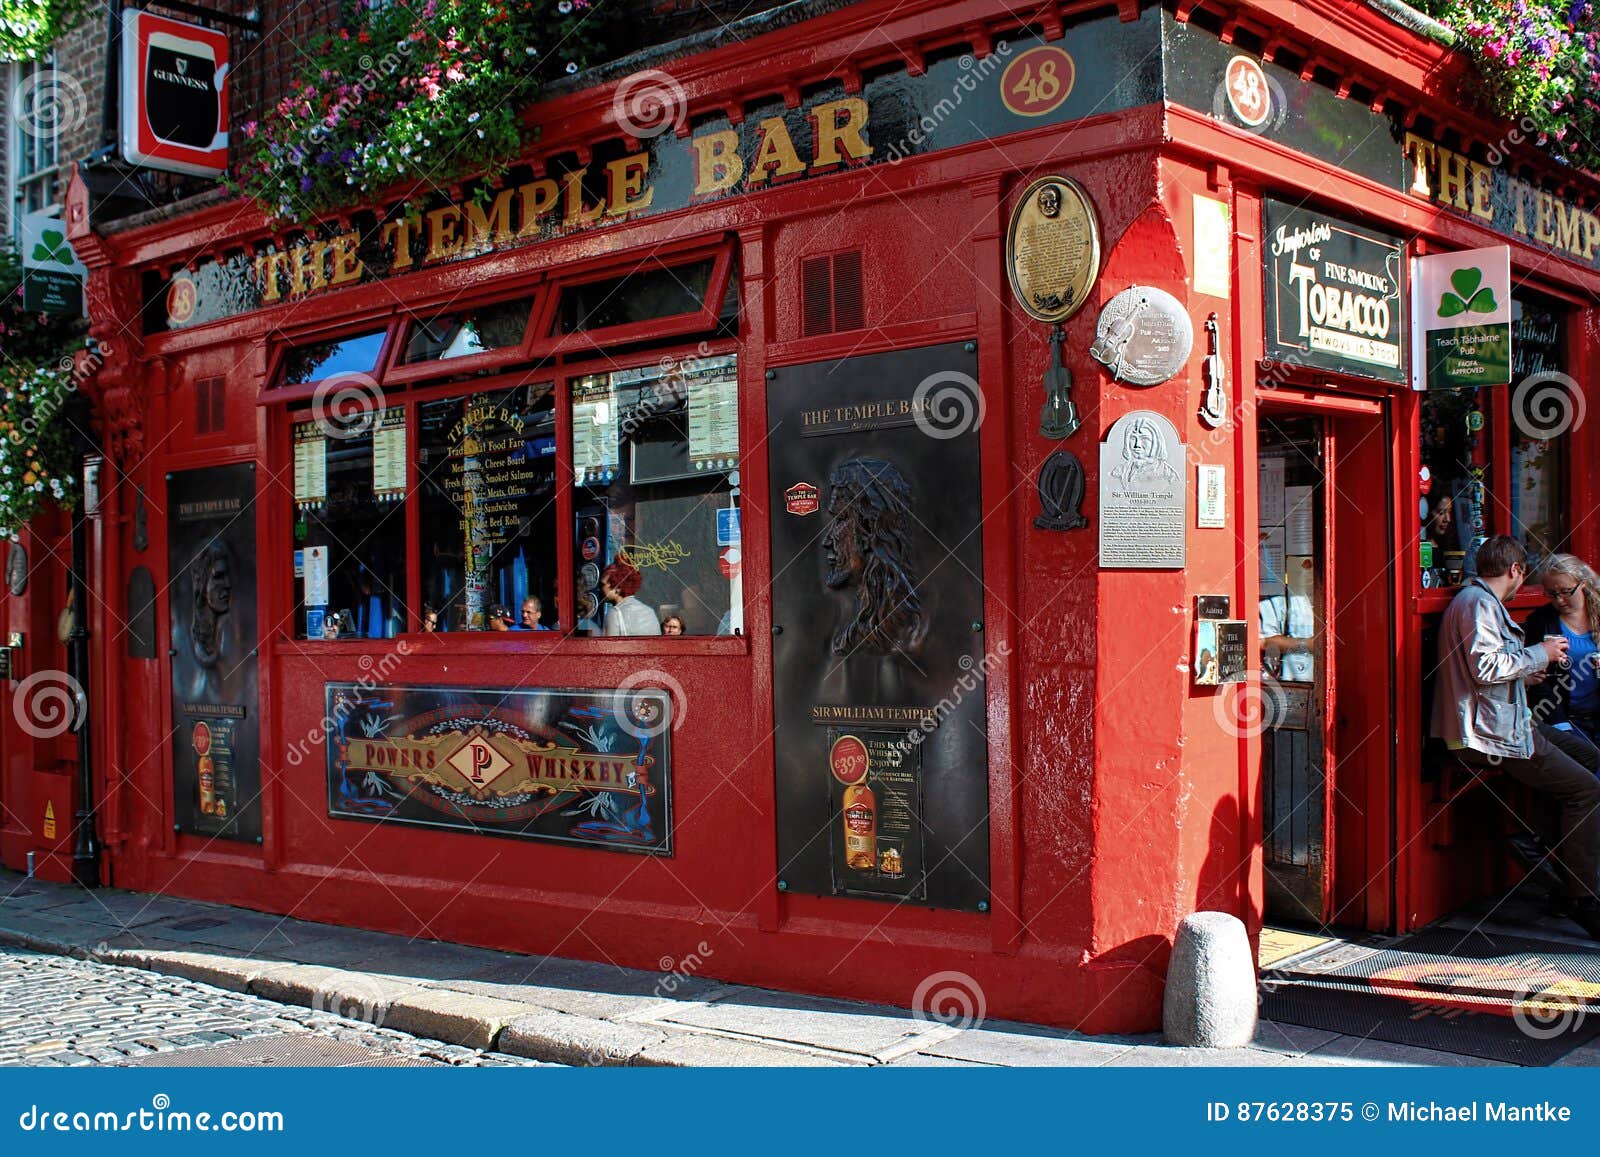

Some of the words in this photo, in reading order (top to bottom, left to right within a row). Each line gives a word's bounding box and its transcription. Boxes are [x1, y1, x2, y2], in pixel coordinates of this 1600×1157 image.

[153, 68, 209, 91] GUINNESS
[1011, 59, 1061, 105] 48
[1232, 65, 1260, 110] 48
[1404, 131, 1497, 221] THE
[255, 231, 363, 301] THE
[383, 152, 654, 270] TEMPLE
[692, 97, 875, 196] BAR
[1271, 221, 1332, 263] Importers
[1309, 247, 1321, 261] OF
[1324, 261, 1347, 283] FINE
[1347, 268, 1389, 294] SMOKING
[1288, 262, 1391, 339] TOBACCO
[1312, 328, 1351, 352] Always
[1436, 336, 1459, 348] Teach
[1460, 346, 1476, 356] Pub
[1451, 366, 1485, 376] APPROVED
[801, 410, 830, 426] THE
[834, 401, 896, 422] TEMPLE
[899, 397, 931, 415] BAR
[447, 405, 496, 443] TEMPLE
[500, 407, 525, 436] BAR
[488, 439, 506, 452] Food
[508, 438, 525, 449] Fare
[485, 457, 505, 469] Cheese
[507, 455, 526, 467] Board
[444, 478, 461, 489] Fresh
[485, 471, 509, 484] Smoked
[510, 469, 534, 482] Salmon
[507, 485, 526, 496] Olives
[1111, 491, 1121, 499] Sir
[1123, 491, 1149, 499] William
[1150, 491, 1174, 501] Temple
[484, 501, 518, 514] Sandwiches
[489, 515, 503, 527] Beef
[504, 514, 521, 526] Rolls
[1227, 633, 1239, 641] THE
[813, 708, 831, 718] SIR
[831, 707, 884, 720] WILLIAM
[887, 708, 936, 721] TEMPLE
[869, 740, 886, 749] THIS
[896, 740, 913, 750] OUR
[364, 743, 437, 770] POWERS
[469, 744, 492, 782] P
[525, 753, 626, 785] WHISKEY
